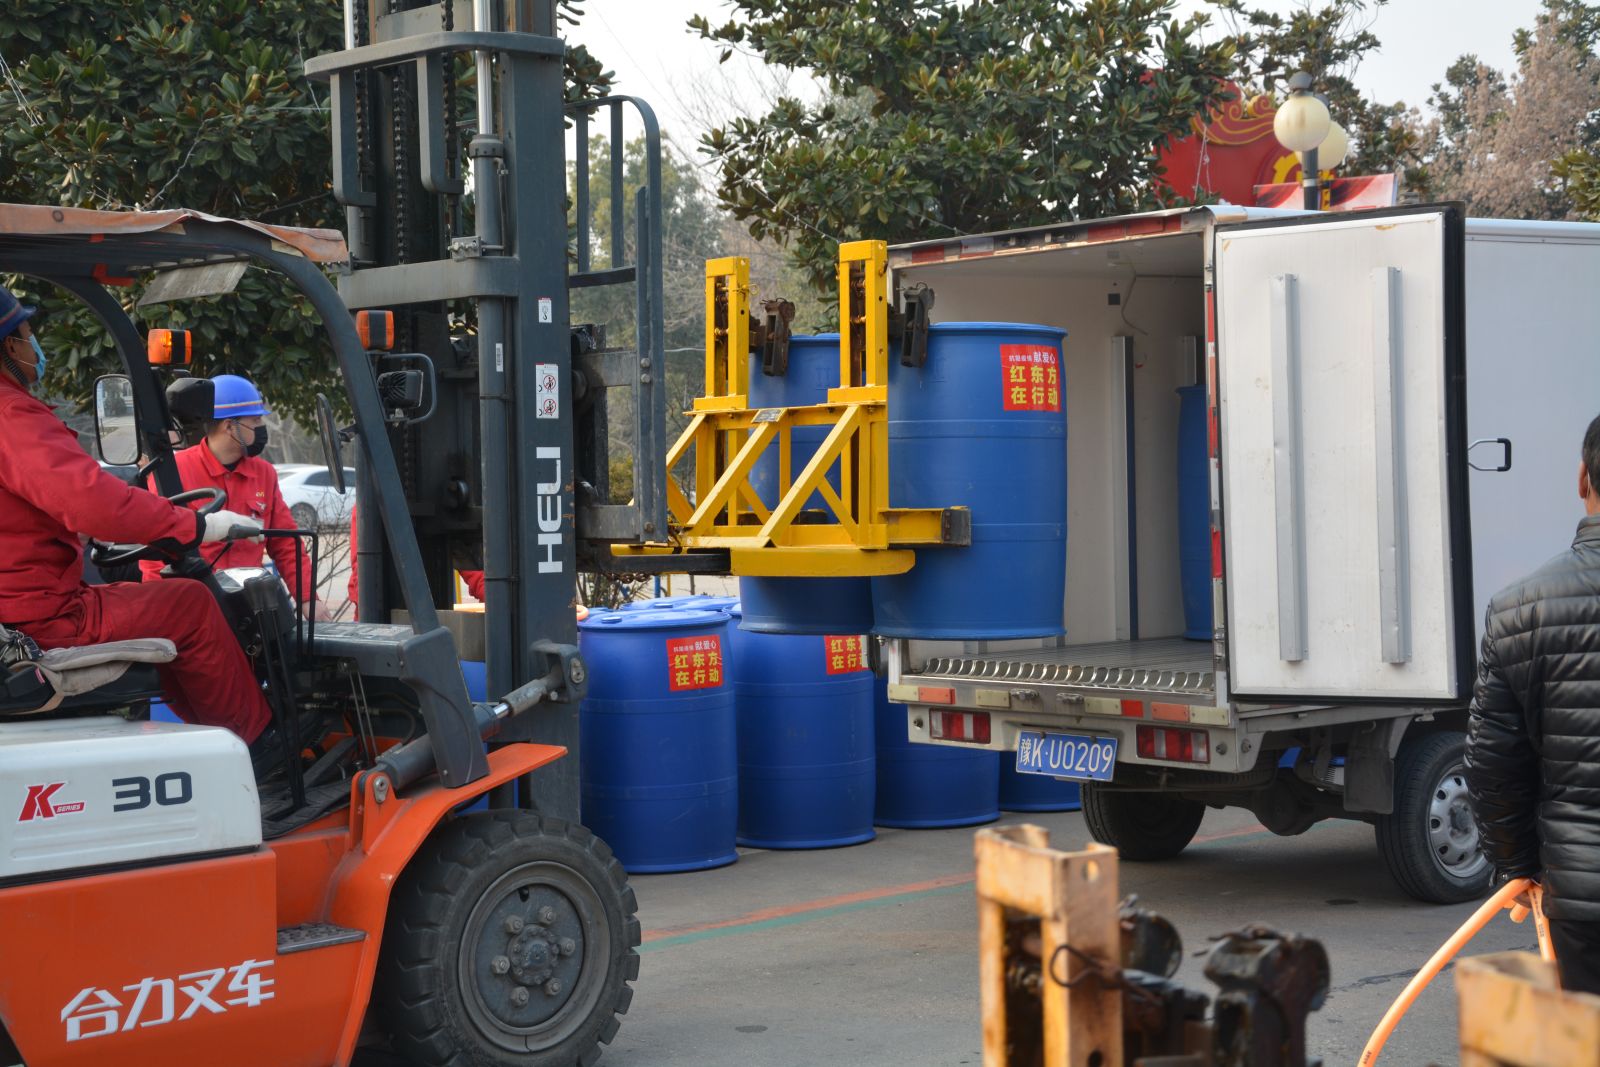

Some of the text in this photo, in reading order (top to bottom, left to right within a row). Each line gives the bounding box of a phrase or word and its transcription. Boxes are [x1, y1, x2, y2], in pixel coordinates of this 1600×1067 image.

[1033, 351, 1056, 364] 献爱心
[1009, 364, 1057, 385] 红东方
[1010, 385, 1058, 406] 在行动
[536, 446, 563, 574] HELI
[694, 640, 716, 651] 献爱心
[674, 651, 718, 669] 红东方
[675, 668, 719, 686] 在行动
[18, 782, 82, 822] K SERIES
[112, 771, 193, 812] 30
[60, 958, 275, 1042] 合力叉车
